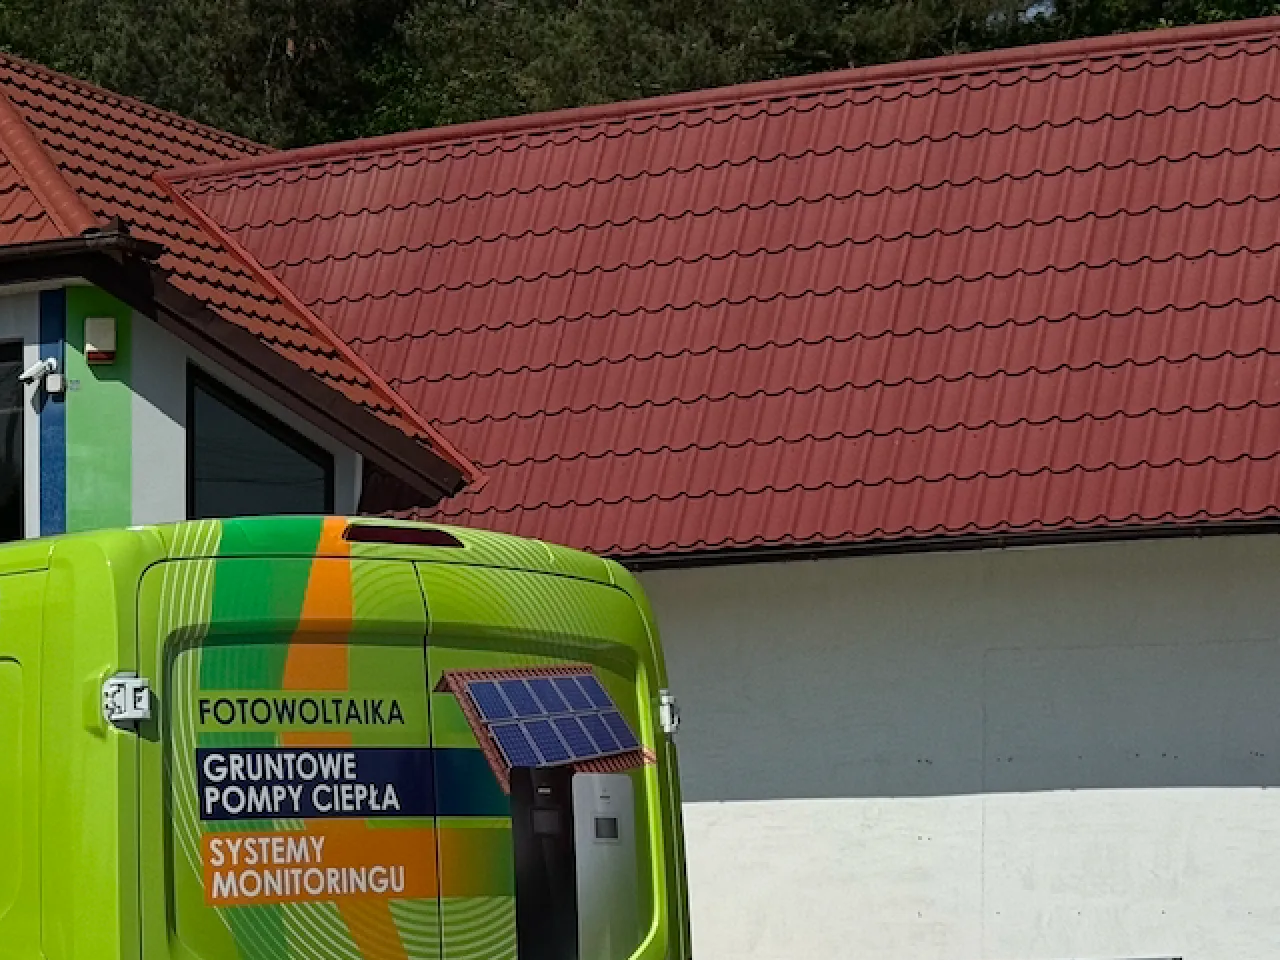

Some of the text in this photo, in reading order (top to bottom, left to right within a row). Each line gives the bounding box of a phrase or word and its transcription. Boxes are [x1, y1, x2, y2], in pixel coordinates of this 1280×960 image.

[199, 697, 405, 726] FOTOWOLTAIKA
[203, 751, 356, 782] GRUNTOWE
[204, 782, 401, 814] POMPY CIEPŁA
[209, 835, 326, 868] SYSTEMY
[211, 865, 406, 899] MONITORINGU
